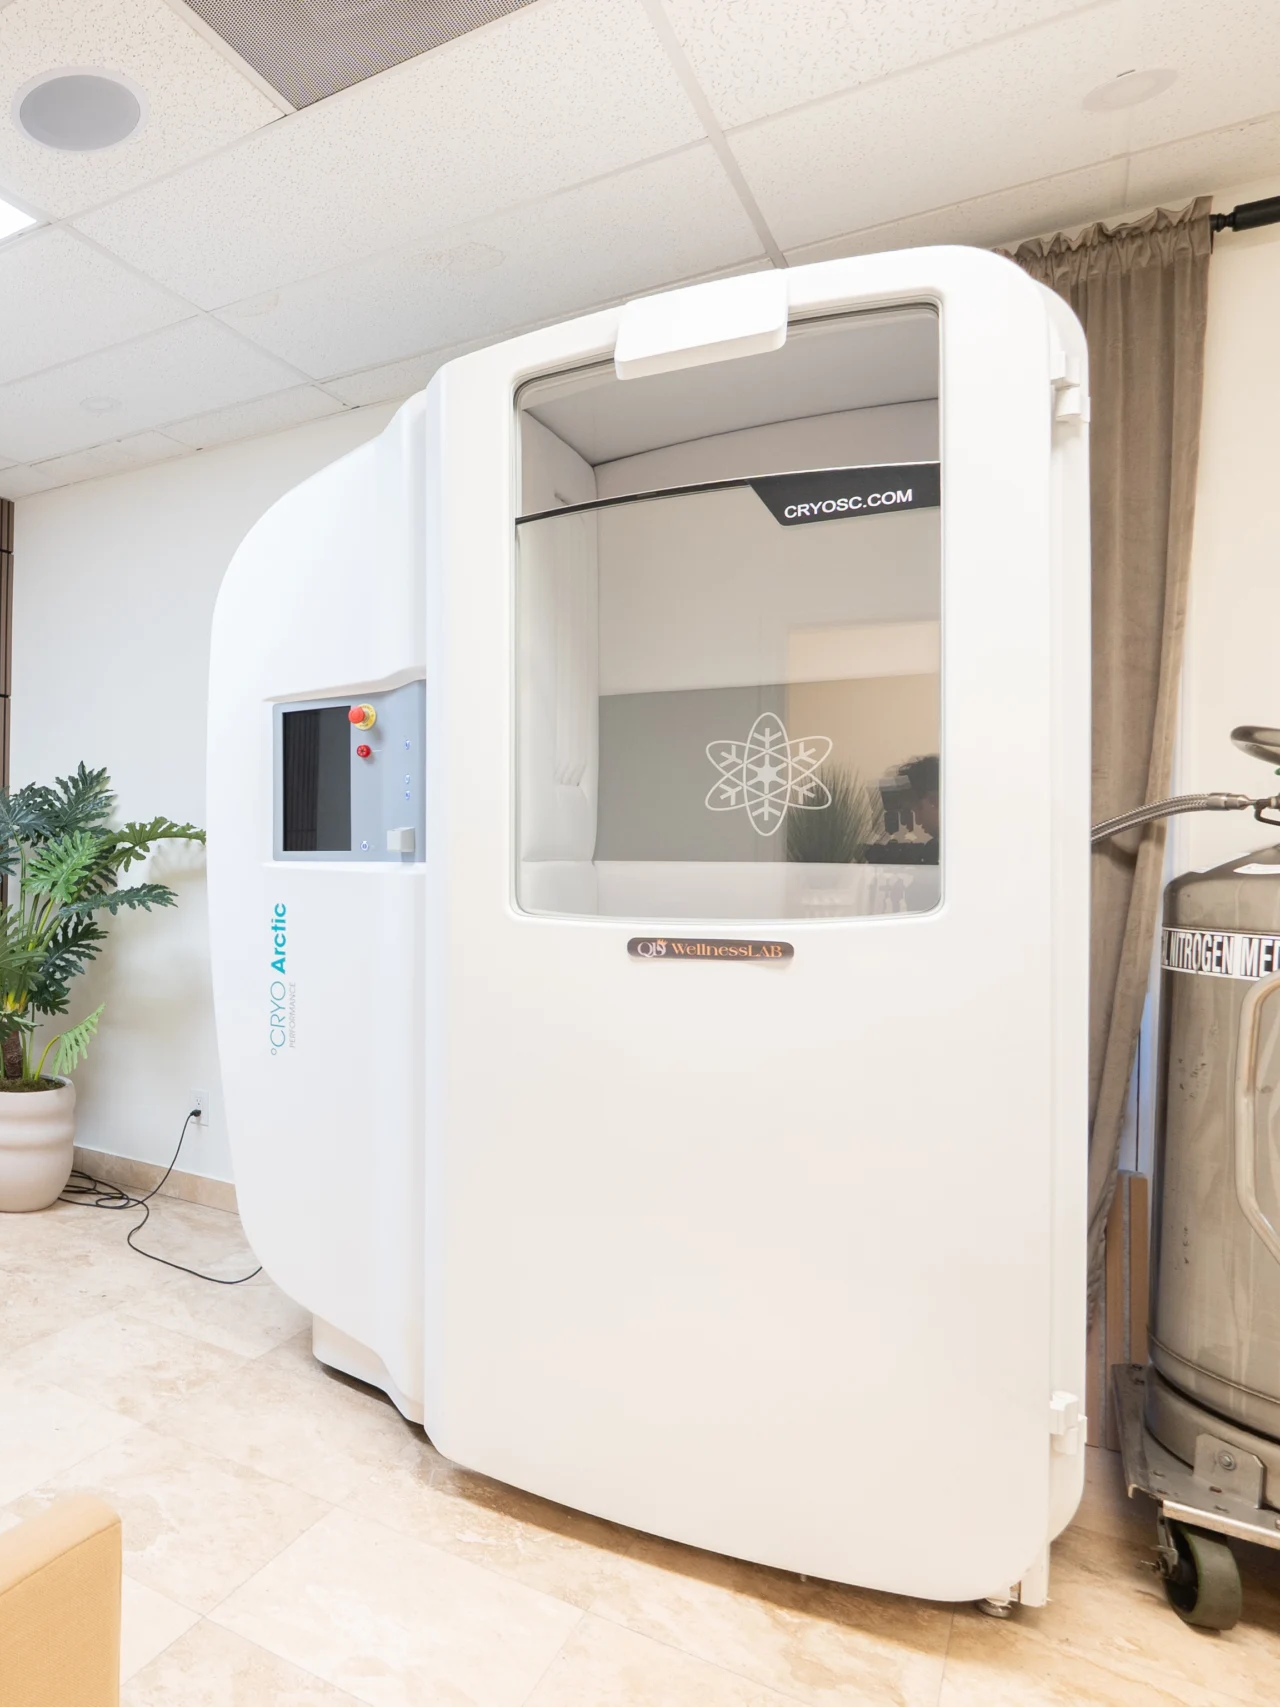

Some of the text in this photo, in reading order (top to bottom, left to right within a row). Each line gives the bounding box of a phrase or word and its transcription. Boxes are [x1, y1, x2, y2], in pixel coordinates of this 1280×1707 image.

[784, 489, 913, 518] CRYOSC.COM
[271, 903, 287, 974] Arctic
[1169, 932, 1234, 974] NITROGEN
